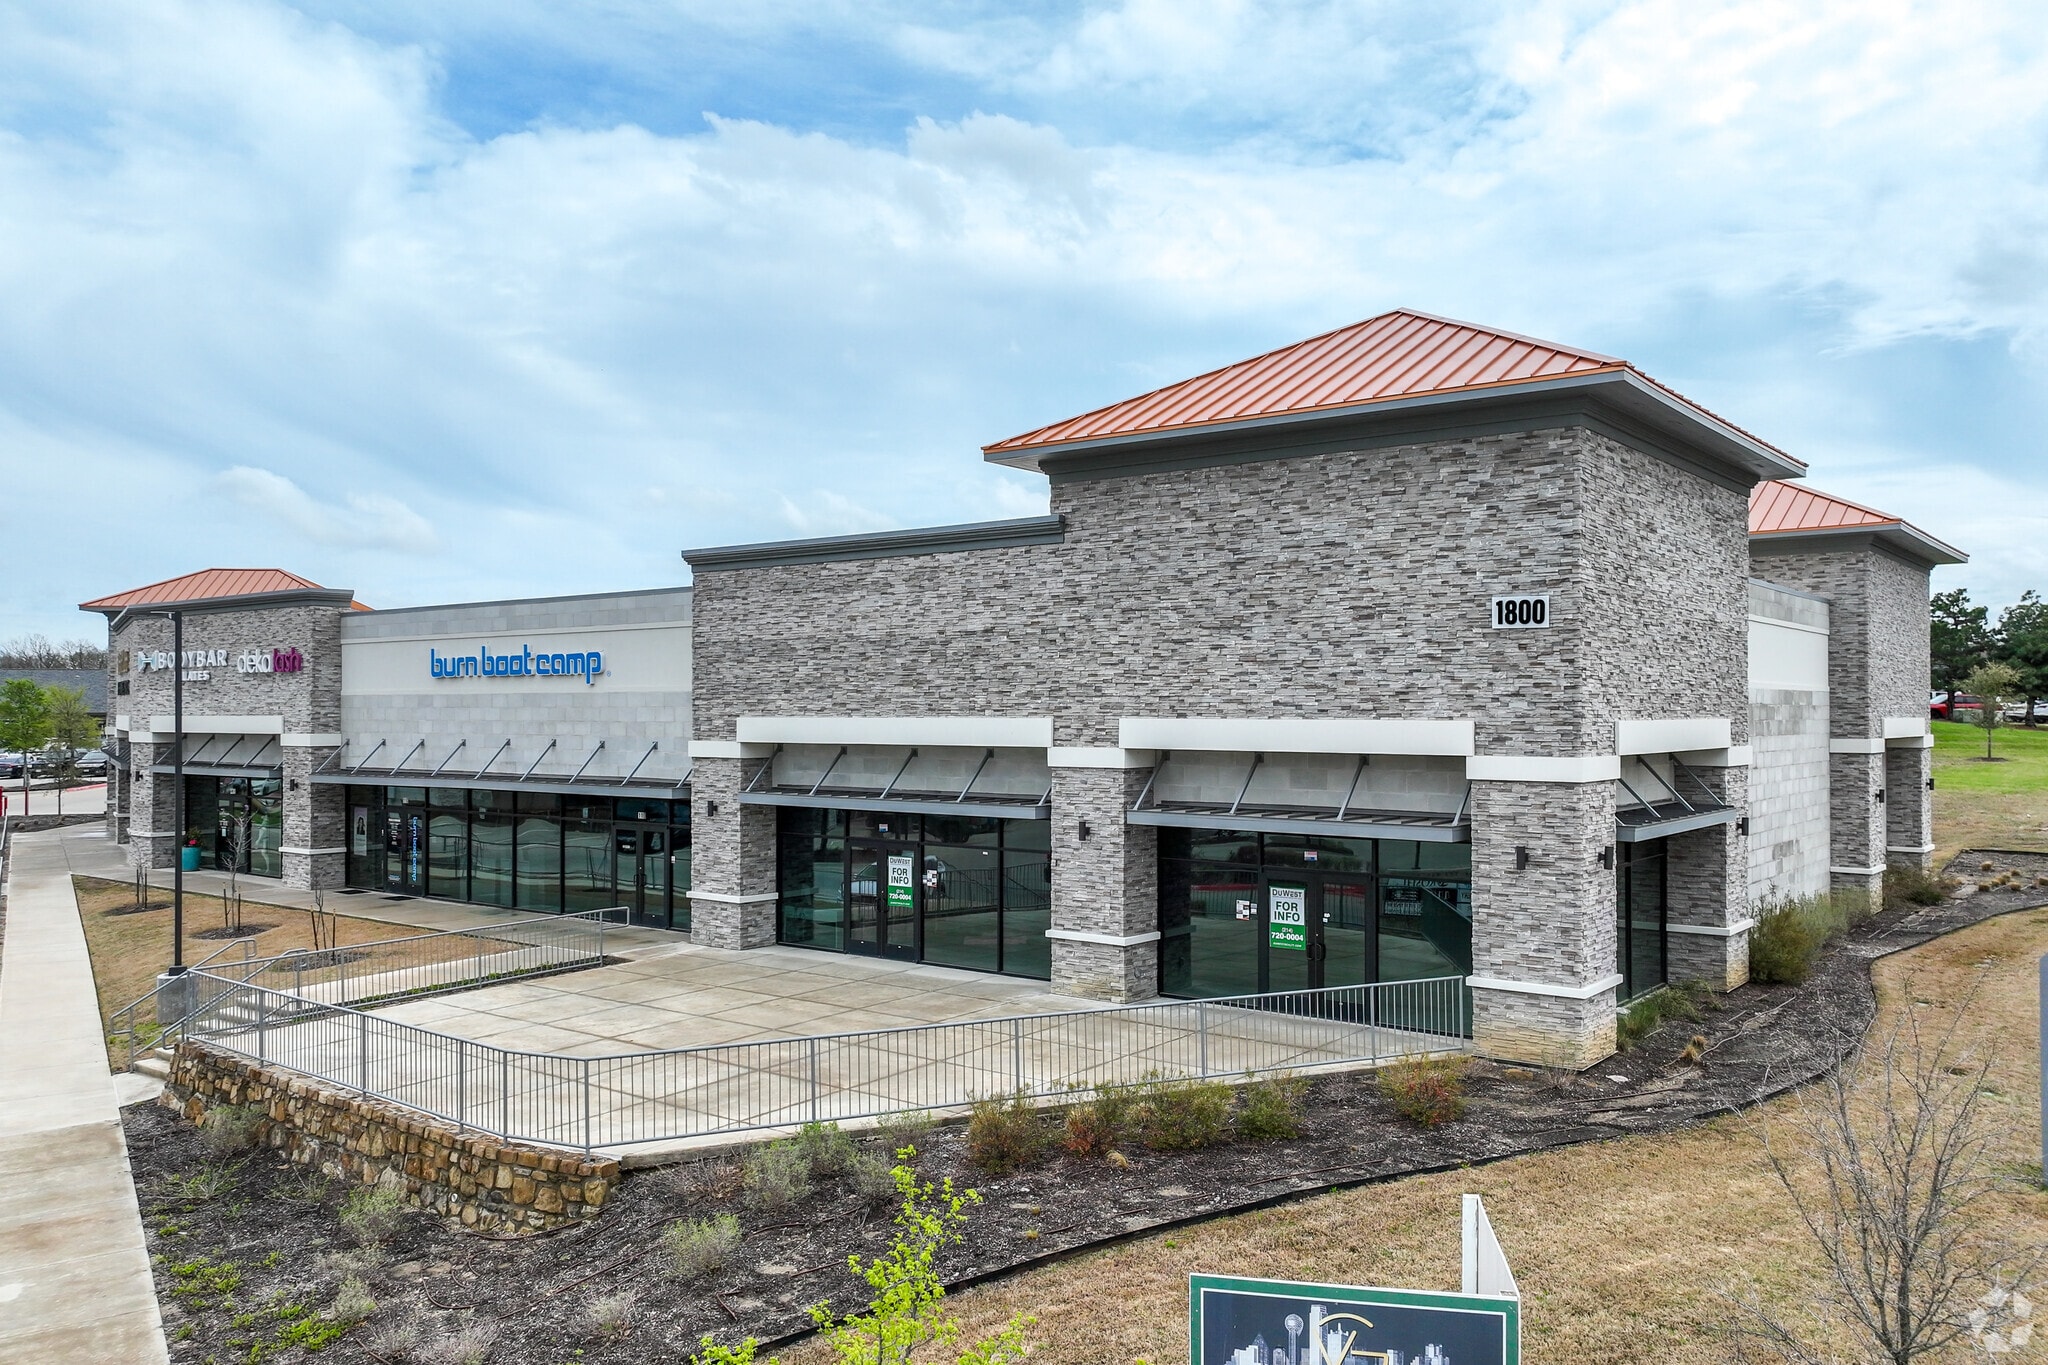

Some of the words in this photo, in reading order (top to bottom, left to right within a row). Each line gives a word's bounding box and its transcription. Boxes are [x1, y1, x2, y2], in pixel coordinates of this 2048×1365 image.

[1495, 599, 1545, 625] 1800
[430, 648, 478, 678] burn
[481, 644, 531, 677] boot
[535, 651, 605, 685] camp
[892, 867, 908, 876] FOR
[891, 876, 909, 885] INFO
[1275, 901, 1299, 912] FOR
[1274, 911, 1300, 922] INFO
[1271, 932, 1304, 941] 720-0004
